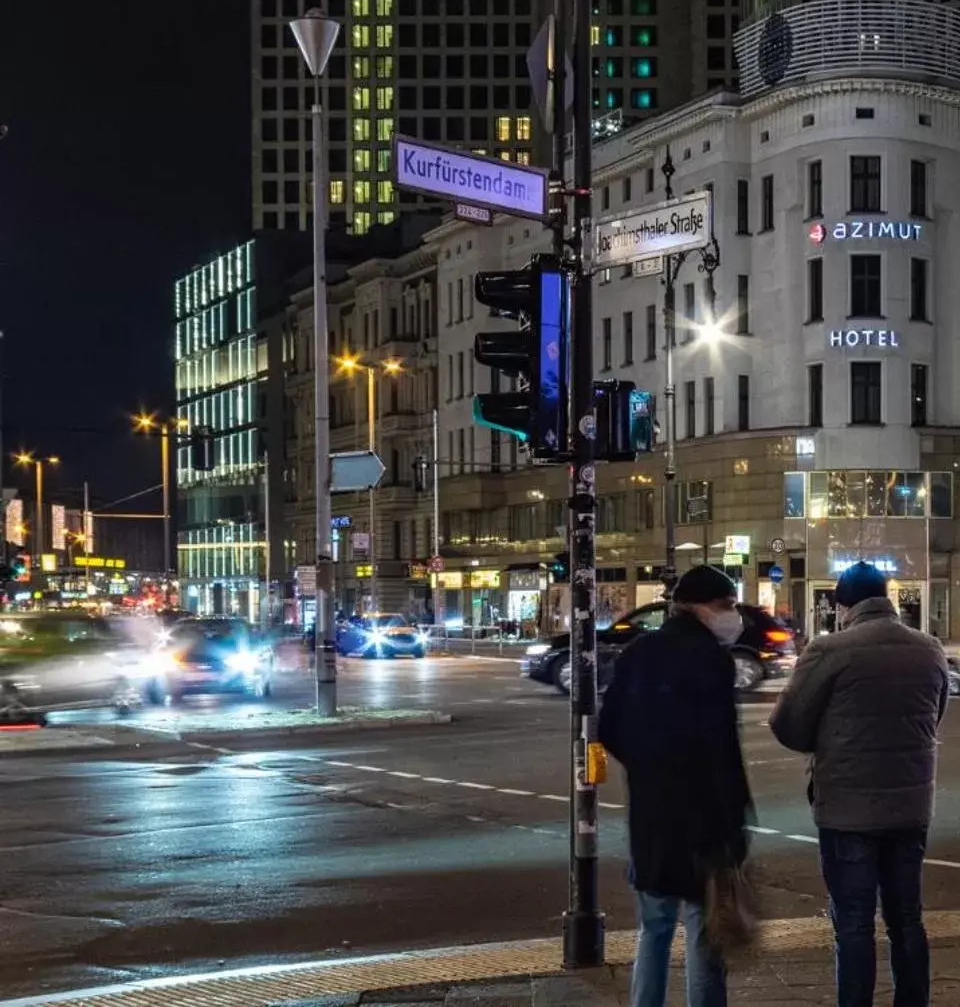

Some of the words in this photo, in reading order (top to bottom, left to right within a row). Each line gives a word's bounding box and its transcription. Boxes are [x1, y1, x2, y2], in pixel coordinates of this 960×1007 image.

[402, 148, 536, 203] Kurfürstendam
[670, 208, 703, 236] Straße
[830, 330, 898, 347] HOTEL
